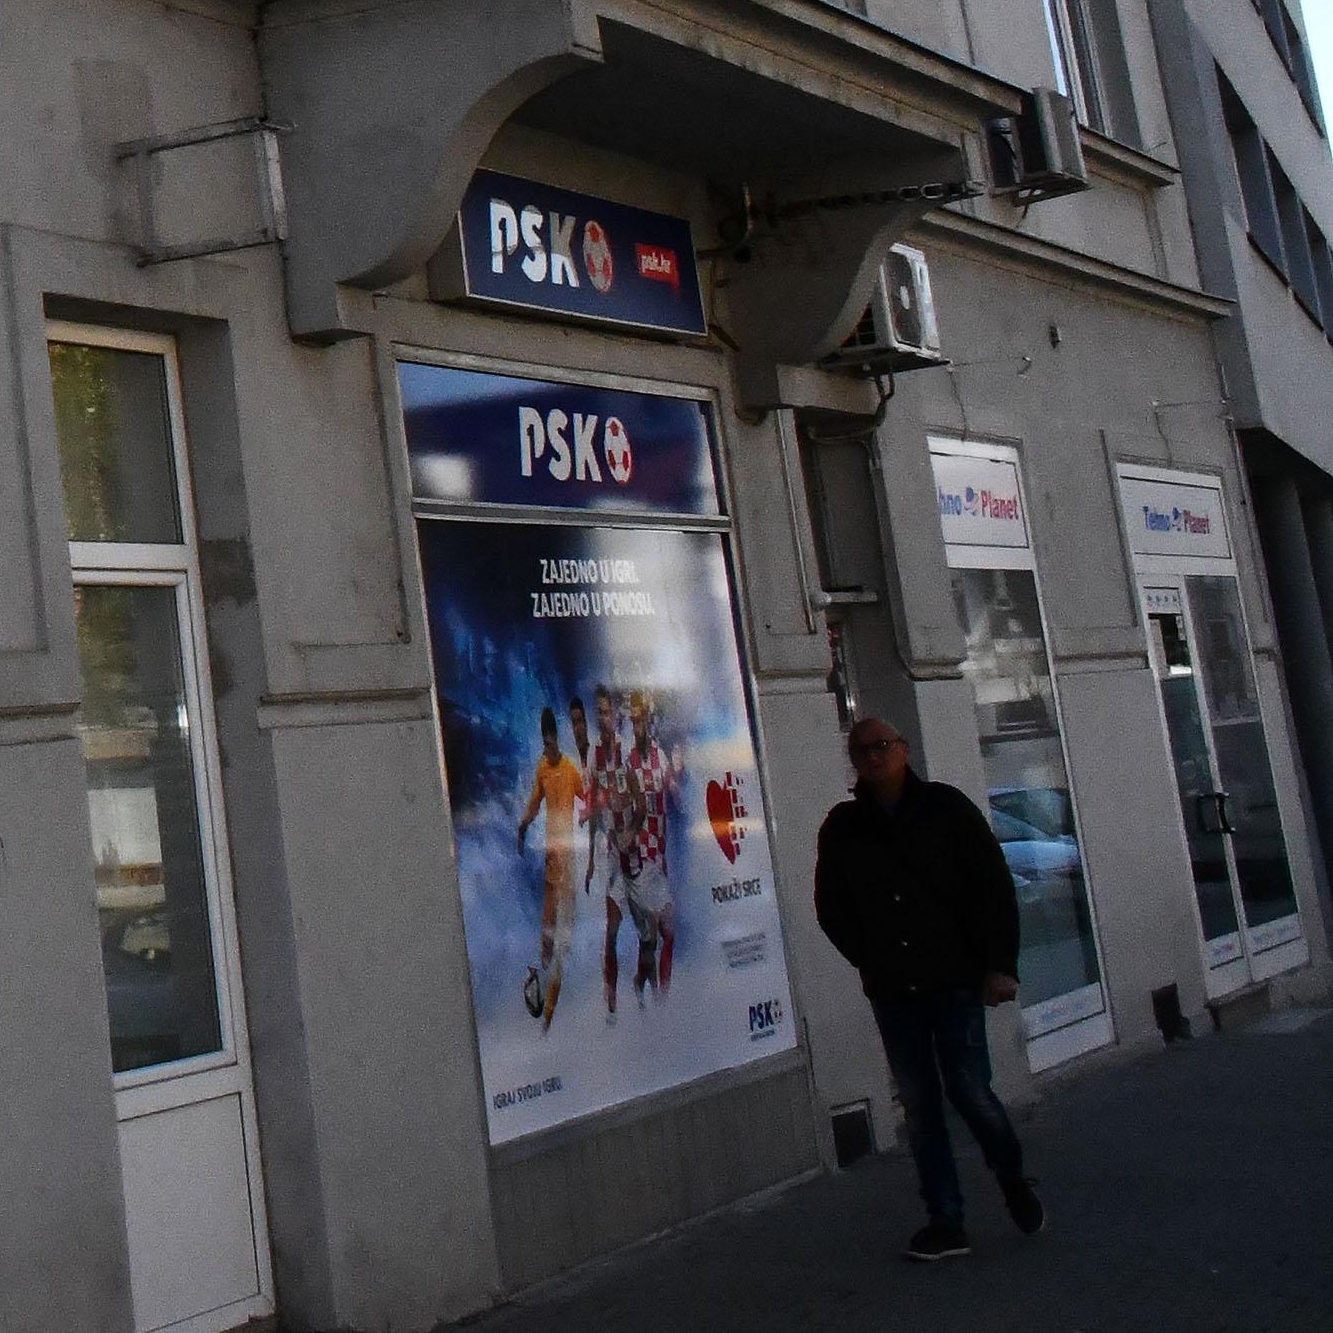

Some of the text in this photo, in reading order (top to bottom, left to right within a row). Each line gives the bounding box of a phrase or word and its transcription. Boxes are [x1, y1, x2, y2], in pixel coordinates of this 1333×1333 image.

[980, 489, 1020, 520] Planet
[539, 558, 598, 584] ZAJEDNO
[598, 559, 609, 584] U
[531, 591, 590, 617] ZAJEDNO
[591, 592, 601, 617] U
[748, 1000, 775, 1032] PSK
